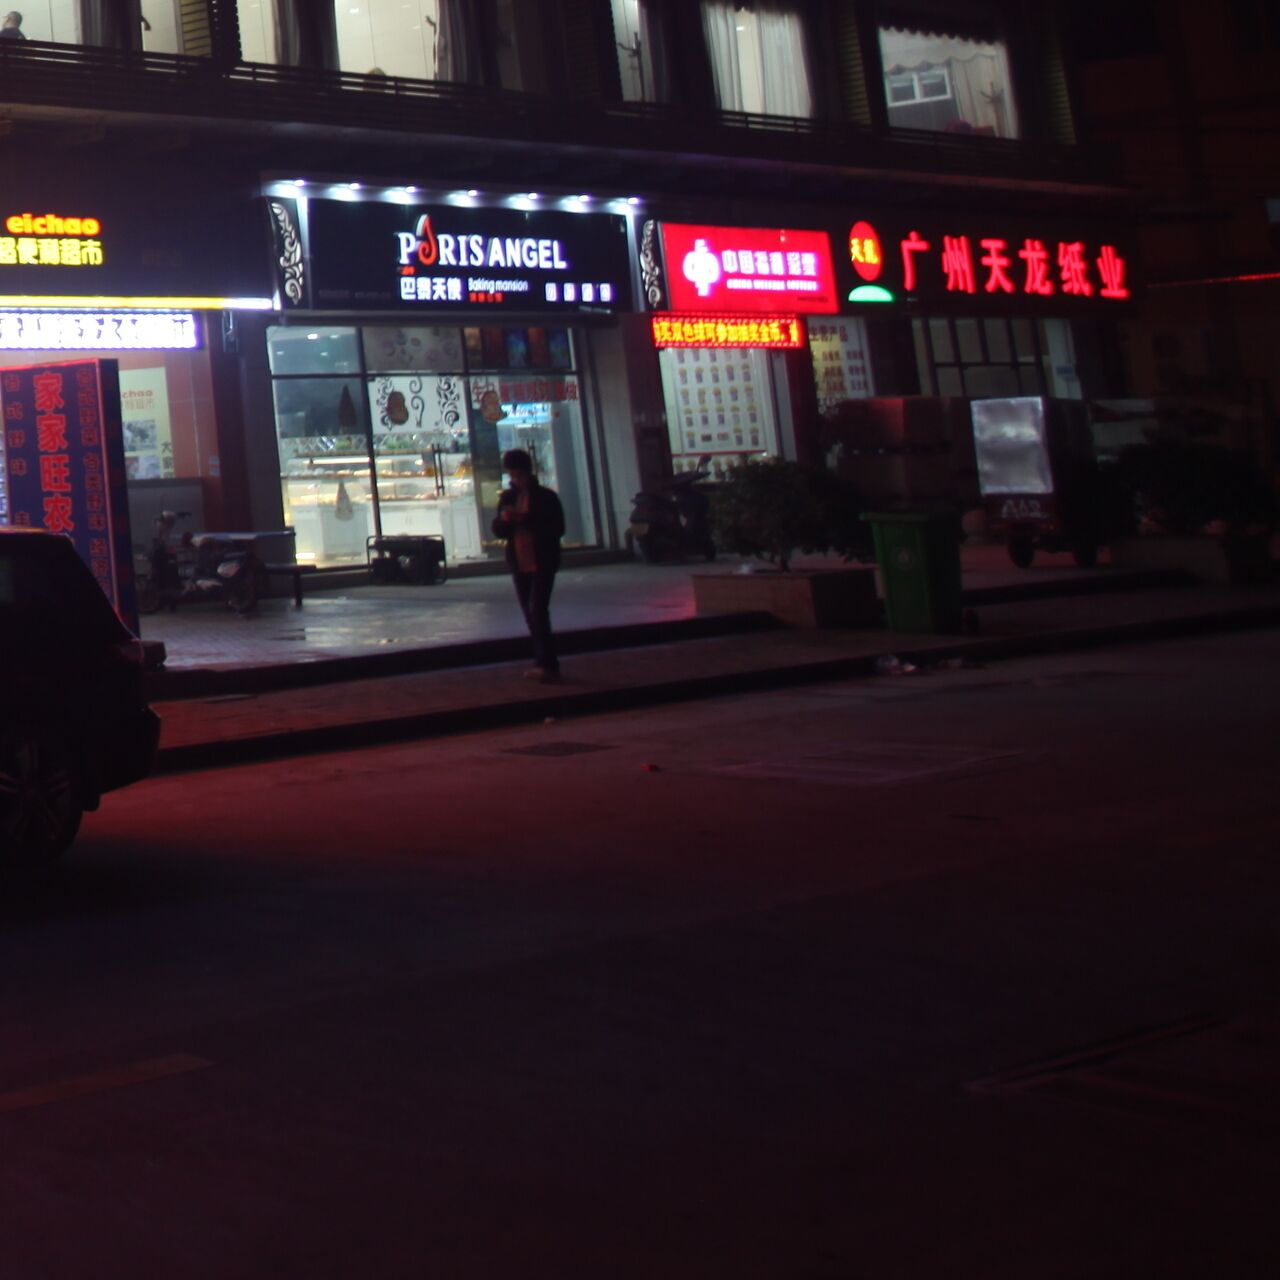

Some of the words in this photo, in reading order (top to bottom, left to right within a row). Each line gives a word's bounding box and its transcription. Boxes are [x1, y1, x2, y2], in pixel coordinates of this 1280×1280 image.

[488, 237, 568, 270] ANGEL
[900, 230, 1130, 299] 广州天龙纸业
[33, 371, 76, 546] 家家旺农
